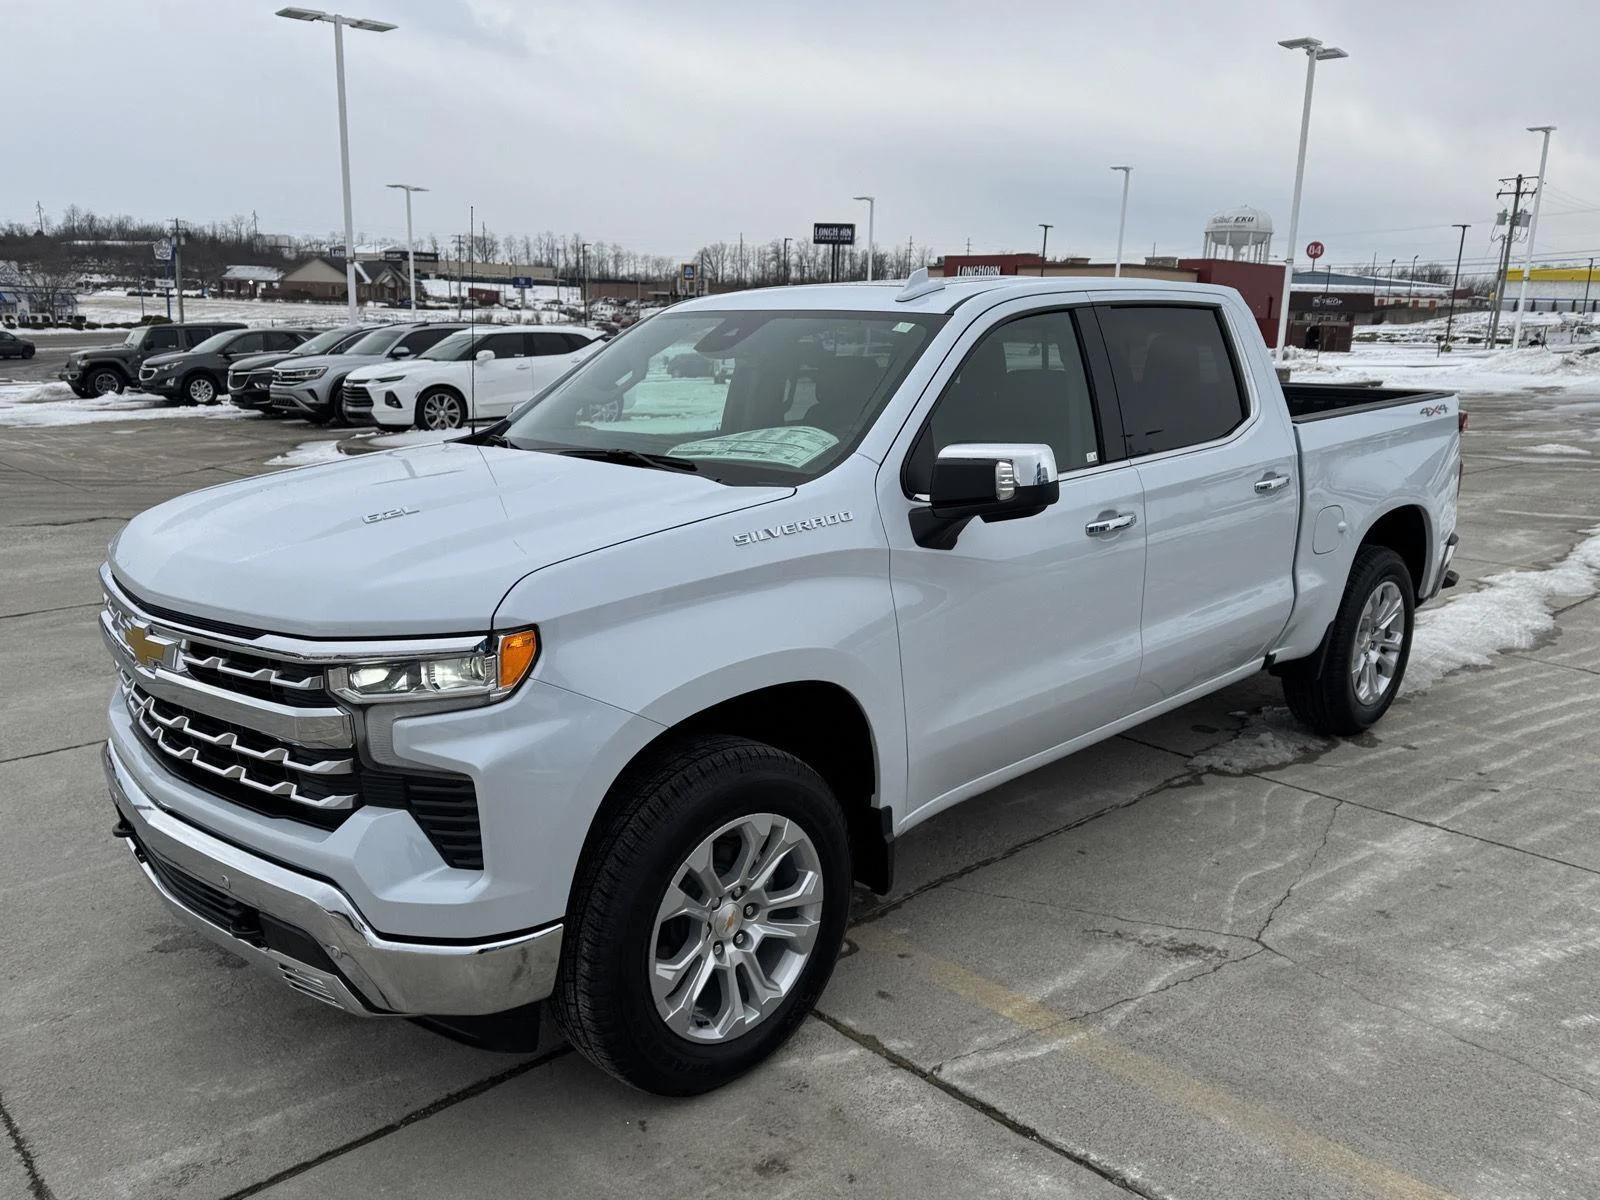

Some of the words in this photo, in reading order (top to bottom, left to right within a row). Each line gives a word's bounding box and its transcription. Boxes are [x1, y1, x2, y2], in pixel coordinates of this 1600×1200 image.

[1308, 245, 1322, 255] 84
[957, 265, 1001, 276] LONGHORN
[733, 511, 853, 546] SILVERADO
